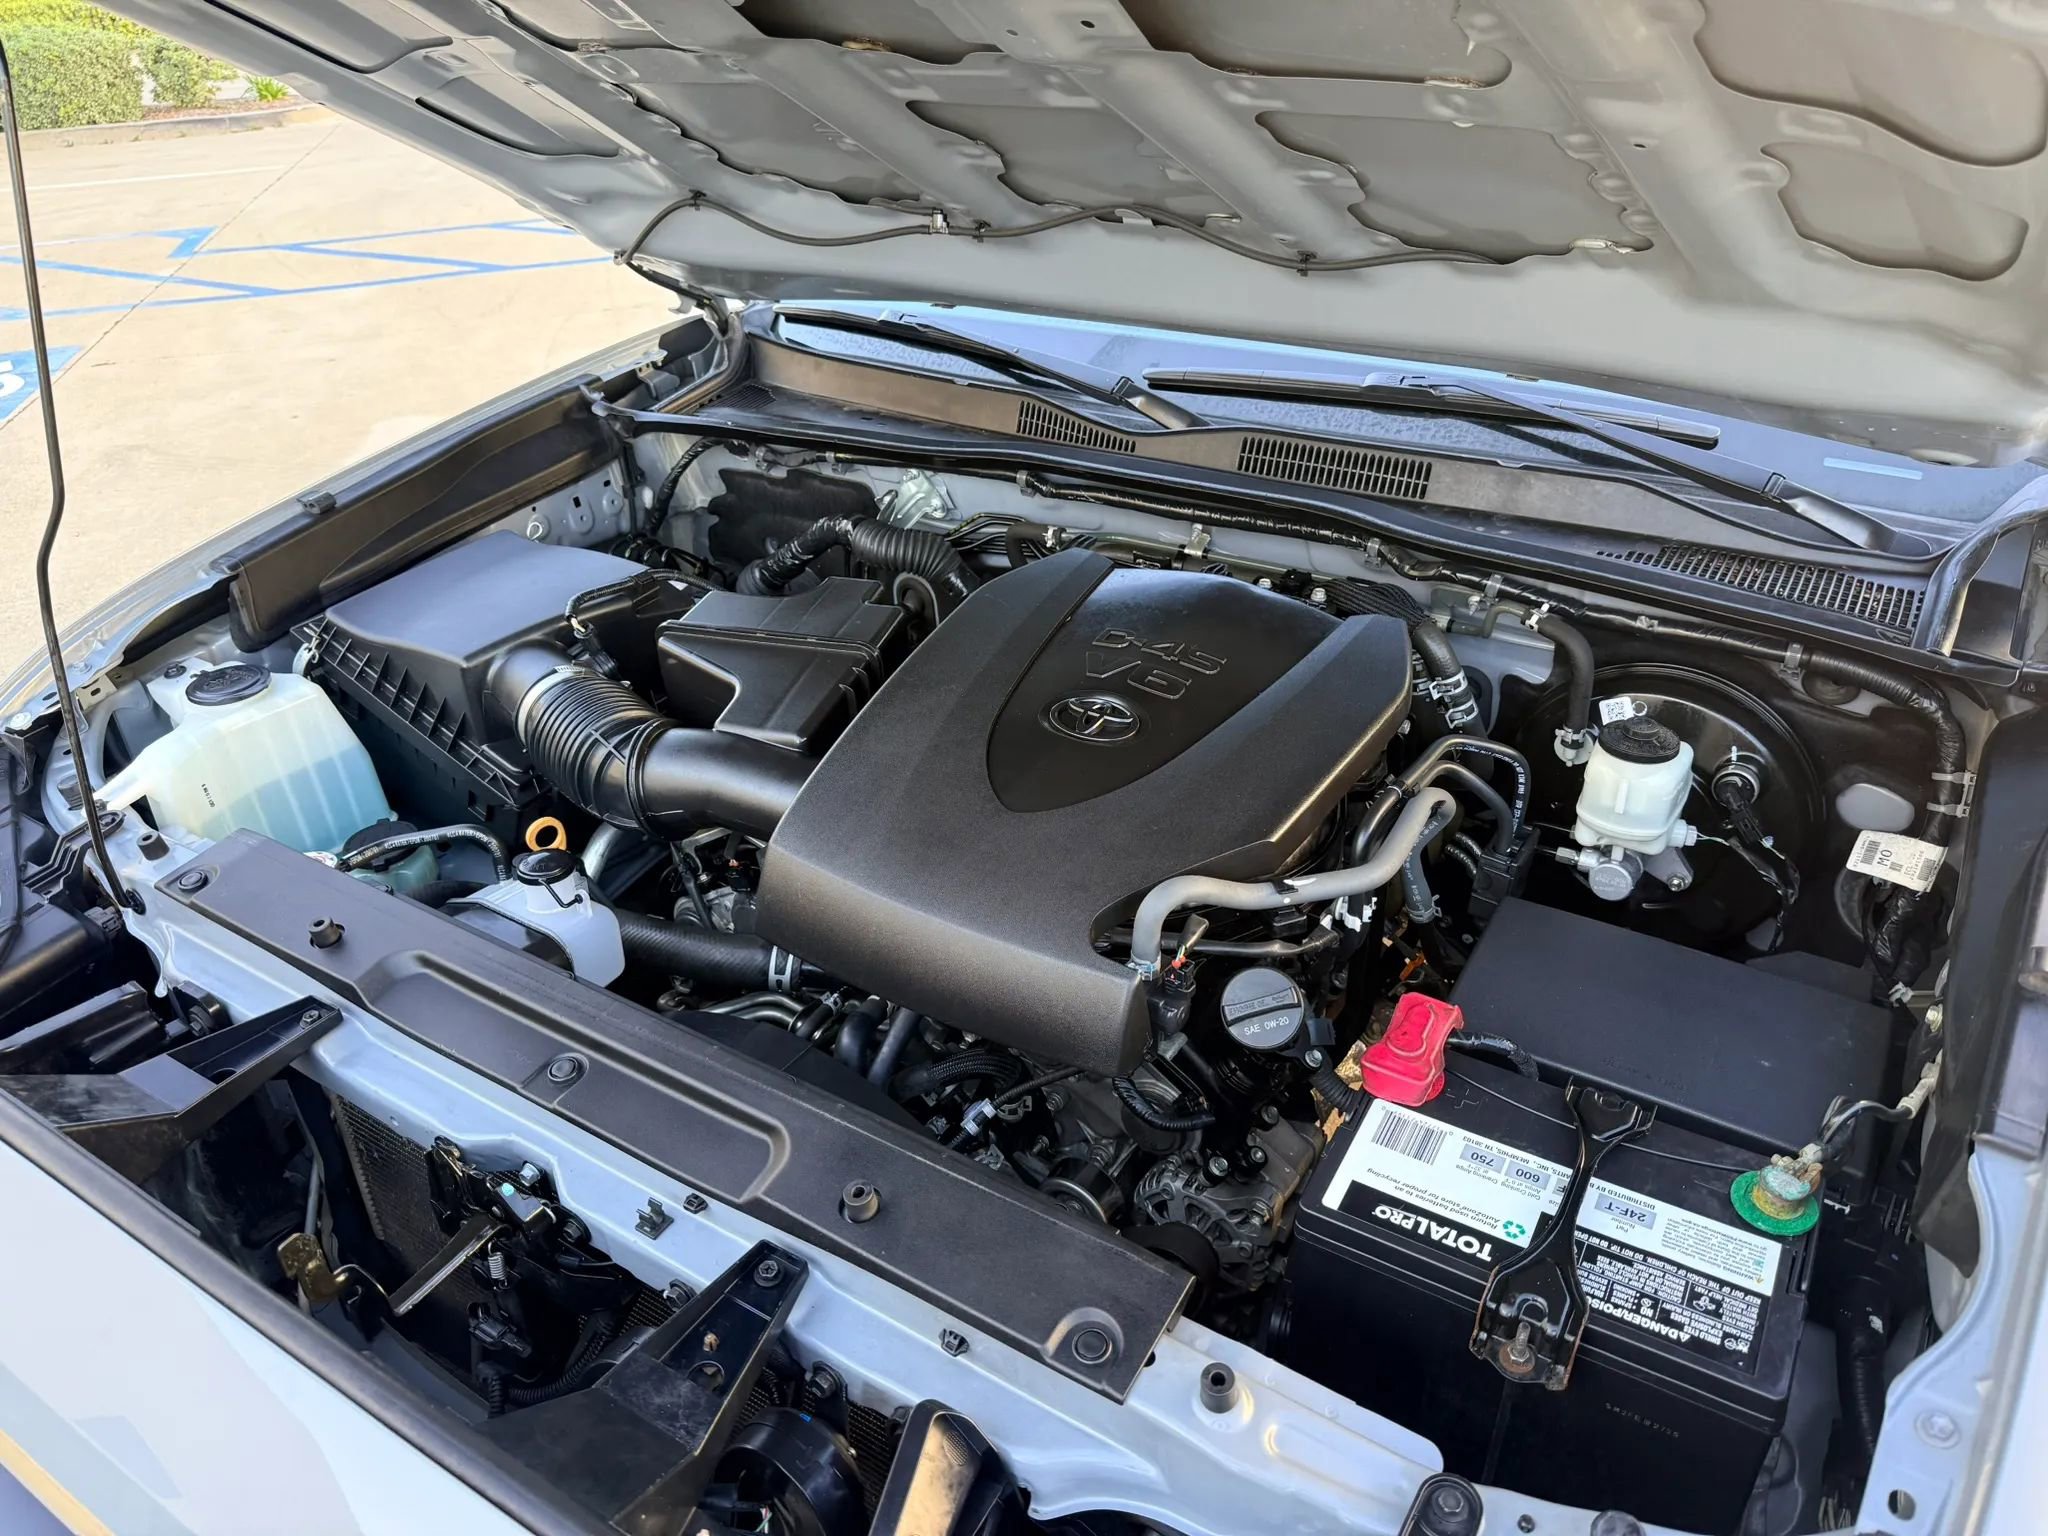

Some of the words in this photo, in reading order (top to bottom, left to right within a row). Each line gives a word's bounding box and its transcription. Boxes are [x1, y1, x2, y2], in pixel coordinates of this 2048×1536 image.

[1091, 627, 1228, 676] D-4S
[1085, 651, 1192, 700] V6
[1244, 1023, 1261, 1036] SAE
[1264, 1016, 1290, 1031] 0W-20
[1484, 1143, 1494, 1151] TN
[1469, 1150, 1495, 1166] 750
[1366, 1167, 1401, 1184] recycling
[1514, 1167, 1540, 1183] 600
[1549, 1166, 1571, 1179] ARTS,
[1401, 1181, 1427, 1194] proper
[1596, 1184, 1606, 1192] BY
[1414, 1193, 1448, 1211] batteries
[1427, 1191, 1439, 1200] for
[1607, 1188, 1655, 1210] DISTRIBUTED
[1439, 1196, 1461, 1209] store
[1448, 1206, 1469, 1218] used
[1604, 1200, 1646, 1222] 24F-T
[1469, 1214, 1497, 1229] Return
[1371, 1200, 1495, 1262] TOTALPRO
[1588, 1235, 1599, 1244] NOT
[1599, 1239, 1608, 1247] DO
[1621, 1247, 1633, 1257] NOT
[1633, 1252, 1643, 1260] DO
[1677, 1268, 1686, 1277] OF
[1686, 1271, 1707, 1285] REACH
[1707, 1279, 1720, 1290] THE
[1720, 1284, 1730, 1294] OF
[1730, 1288, 1744, 1299] OUT
[1744, 1293, 1761, 1305] KEEP
[1640, 1305, 1653, 1317] NO
[1669, 1311, 1689, 1324] GASES
[1683, 1324, 1699, 1336] EYES
[1689, 1319, 1723, 1337] EXPLOSIVE
[1699, 1330, 1721, 1345] SHIELD
